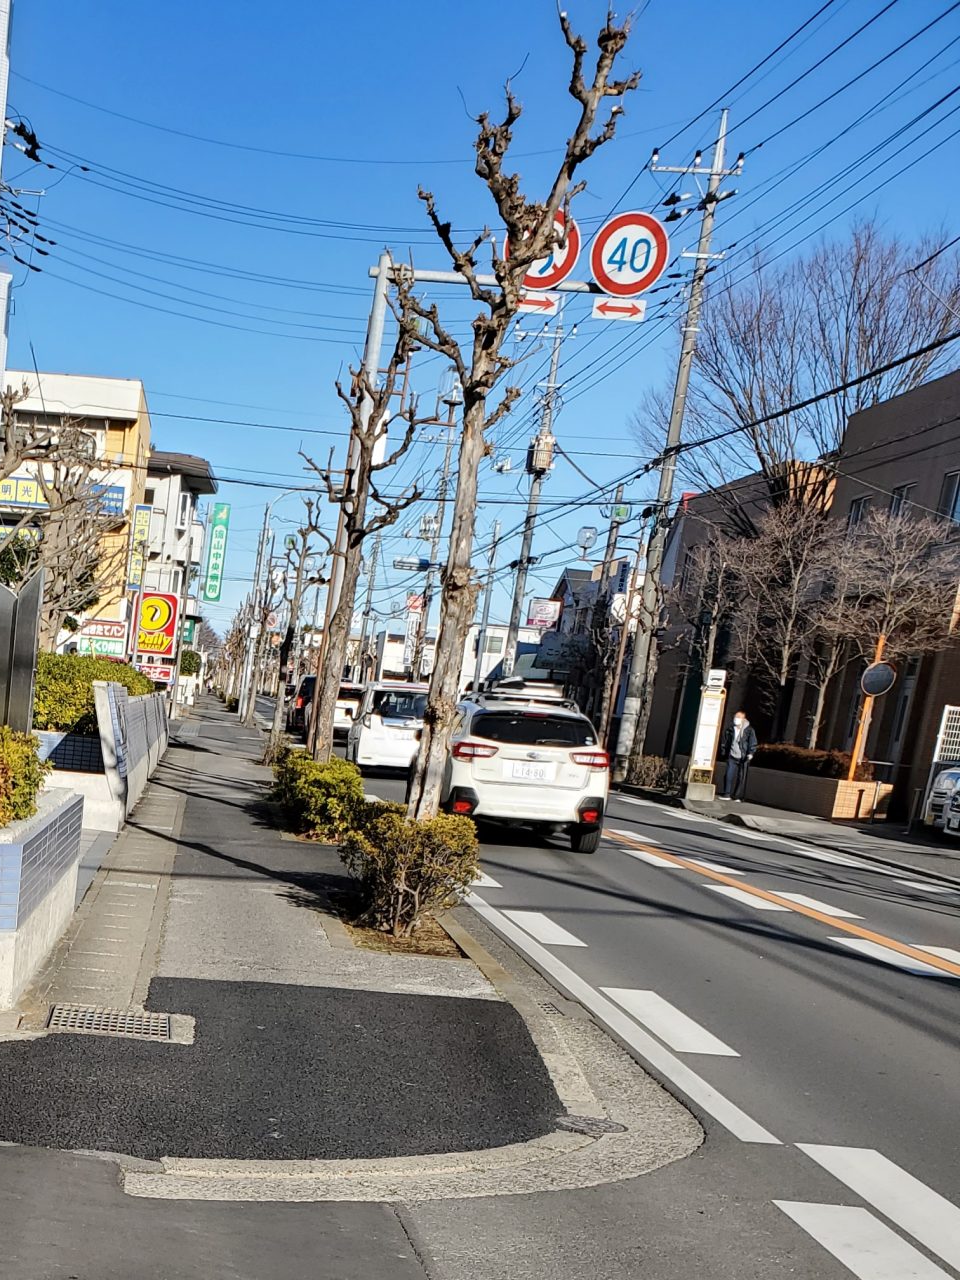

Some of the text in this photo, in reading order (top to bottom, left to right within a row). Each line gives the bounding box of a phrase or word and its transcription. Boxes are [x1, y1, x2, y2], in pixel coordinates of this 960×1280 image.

[607, 236, 652, 274] 40
[208, 529, 224, 594] 流山中央病院
